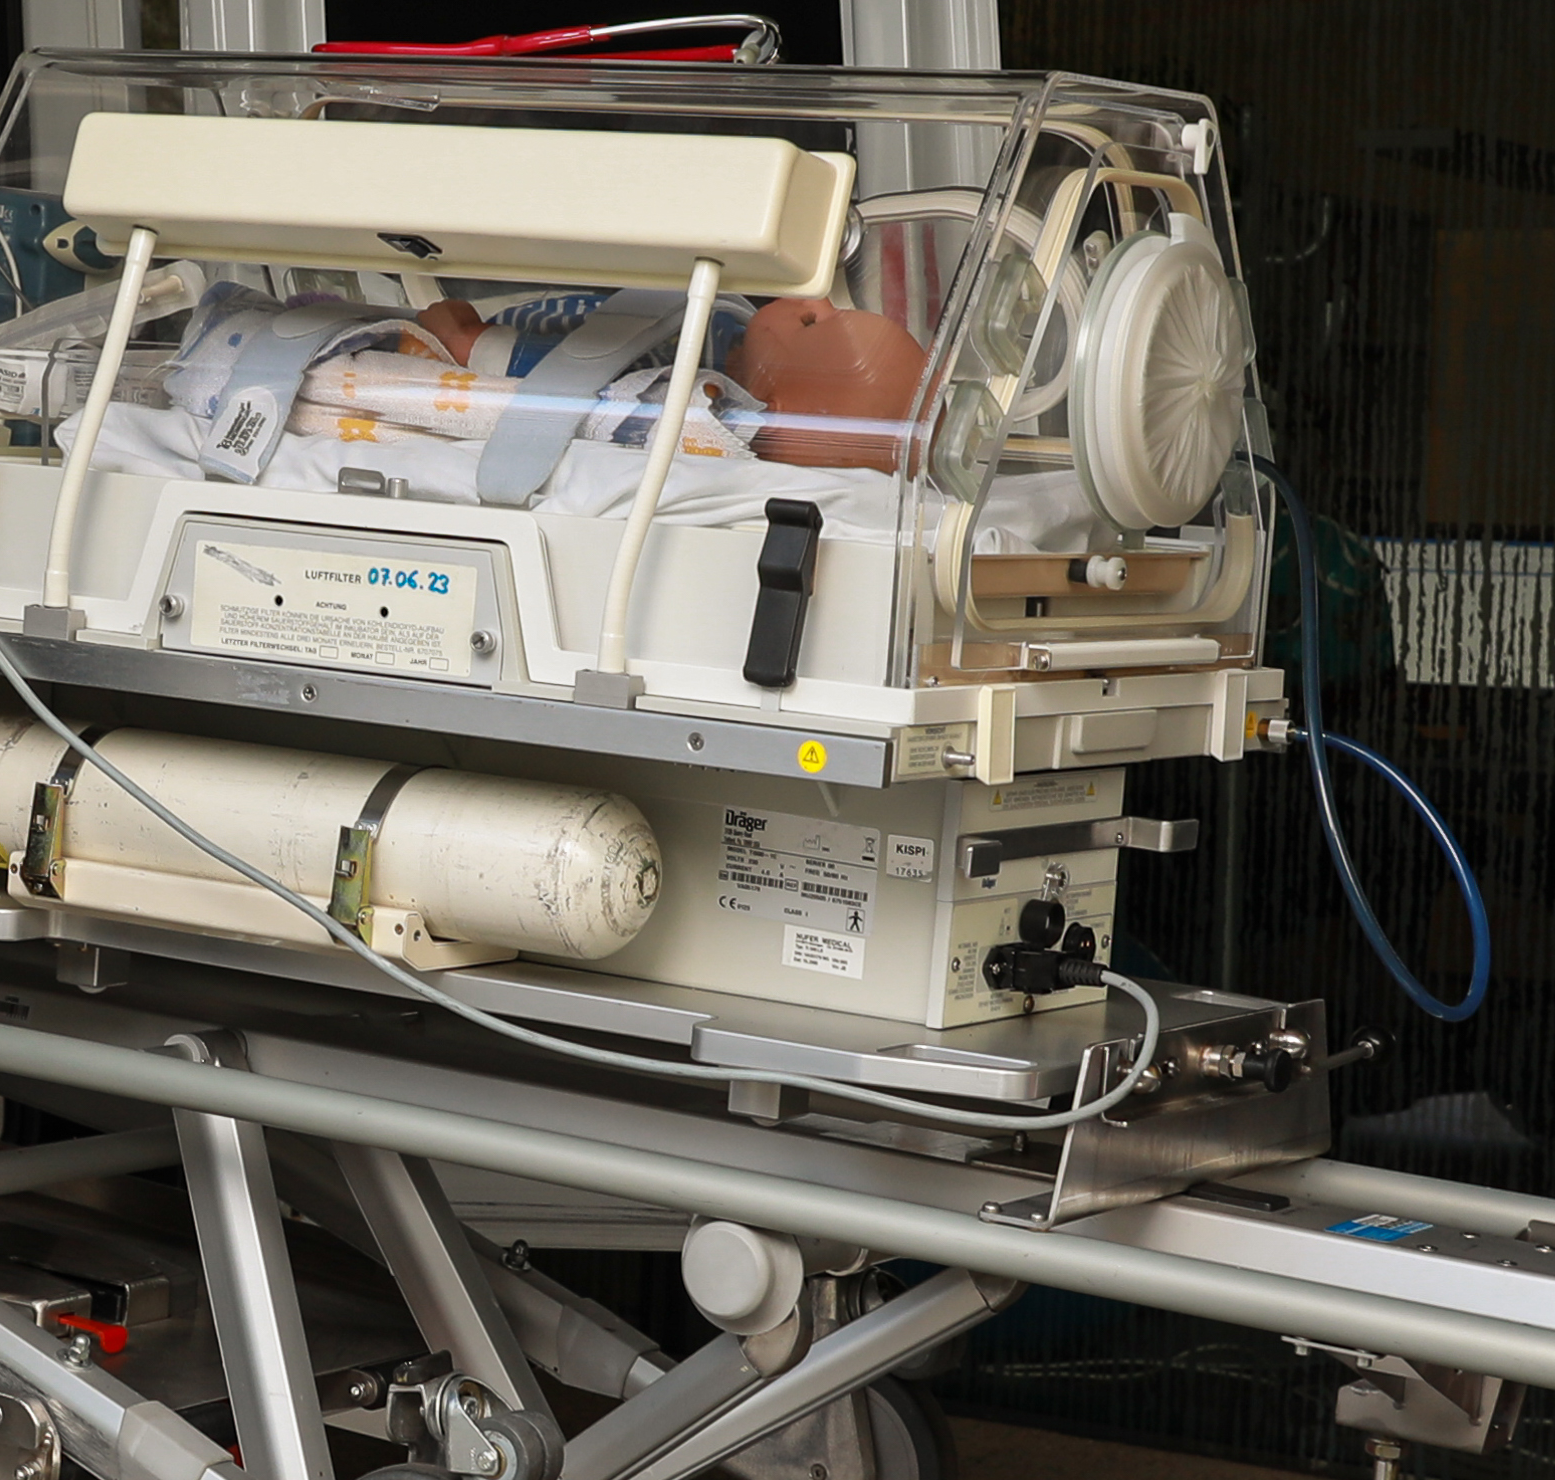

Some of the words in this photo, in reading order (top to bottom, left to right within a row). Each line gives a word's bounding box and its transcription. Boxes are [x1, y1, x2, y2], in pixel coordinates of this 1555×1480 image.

[305, 569, 362, 585] LUFTFILTER
[367, 566, 450, 595] 07.06.23
[315, 601, 347, 610] ACHTUNG
[261, 608, 280, 617] FILTER
[352, 618, 365, 626] VON
[219, 626, 239, 635] FILTER
[281, 632, 296, 640] ALLE
[221, 637, 248, 646] LETZTER
[351, 651, 373, 660] MONAT
[725, 809, 768, 832] Dräger
[895, 843, 926, 857] KISPI
